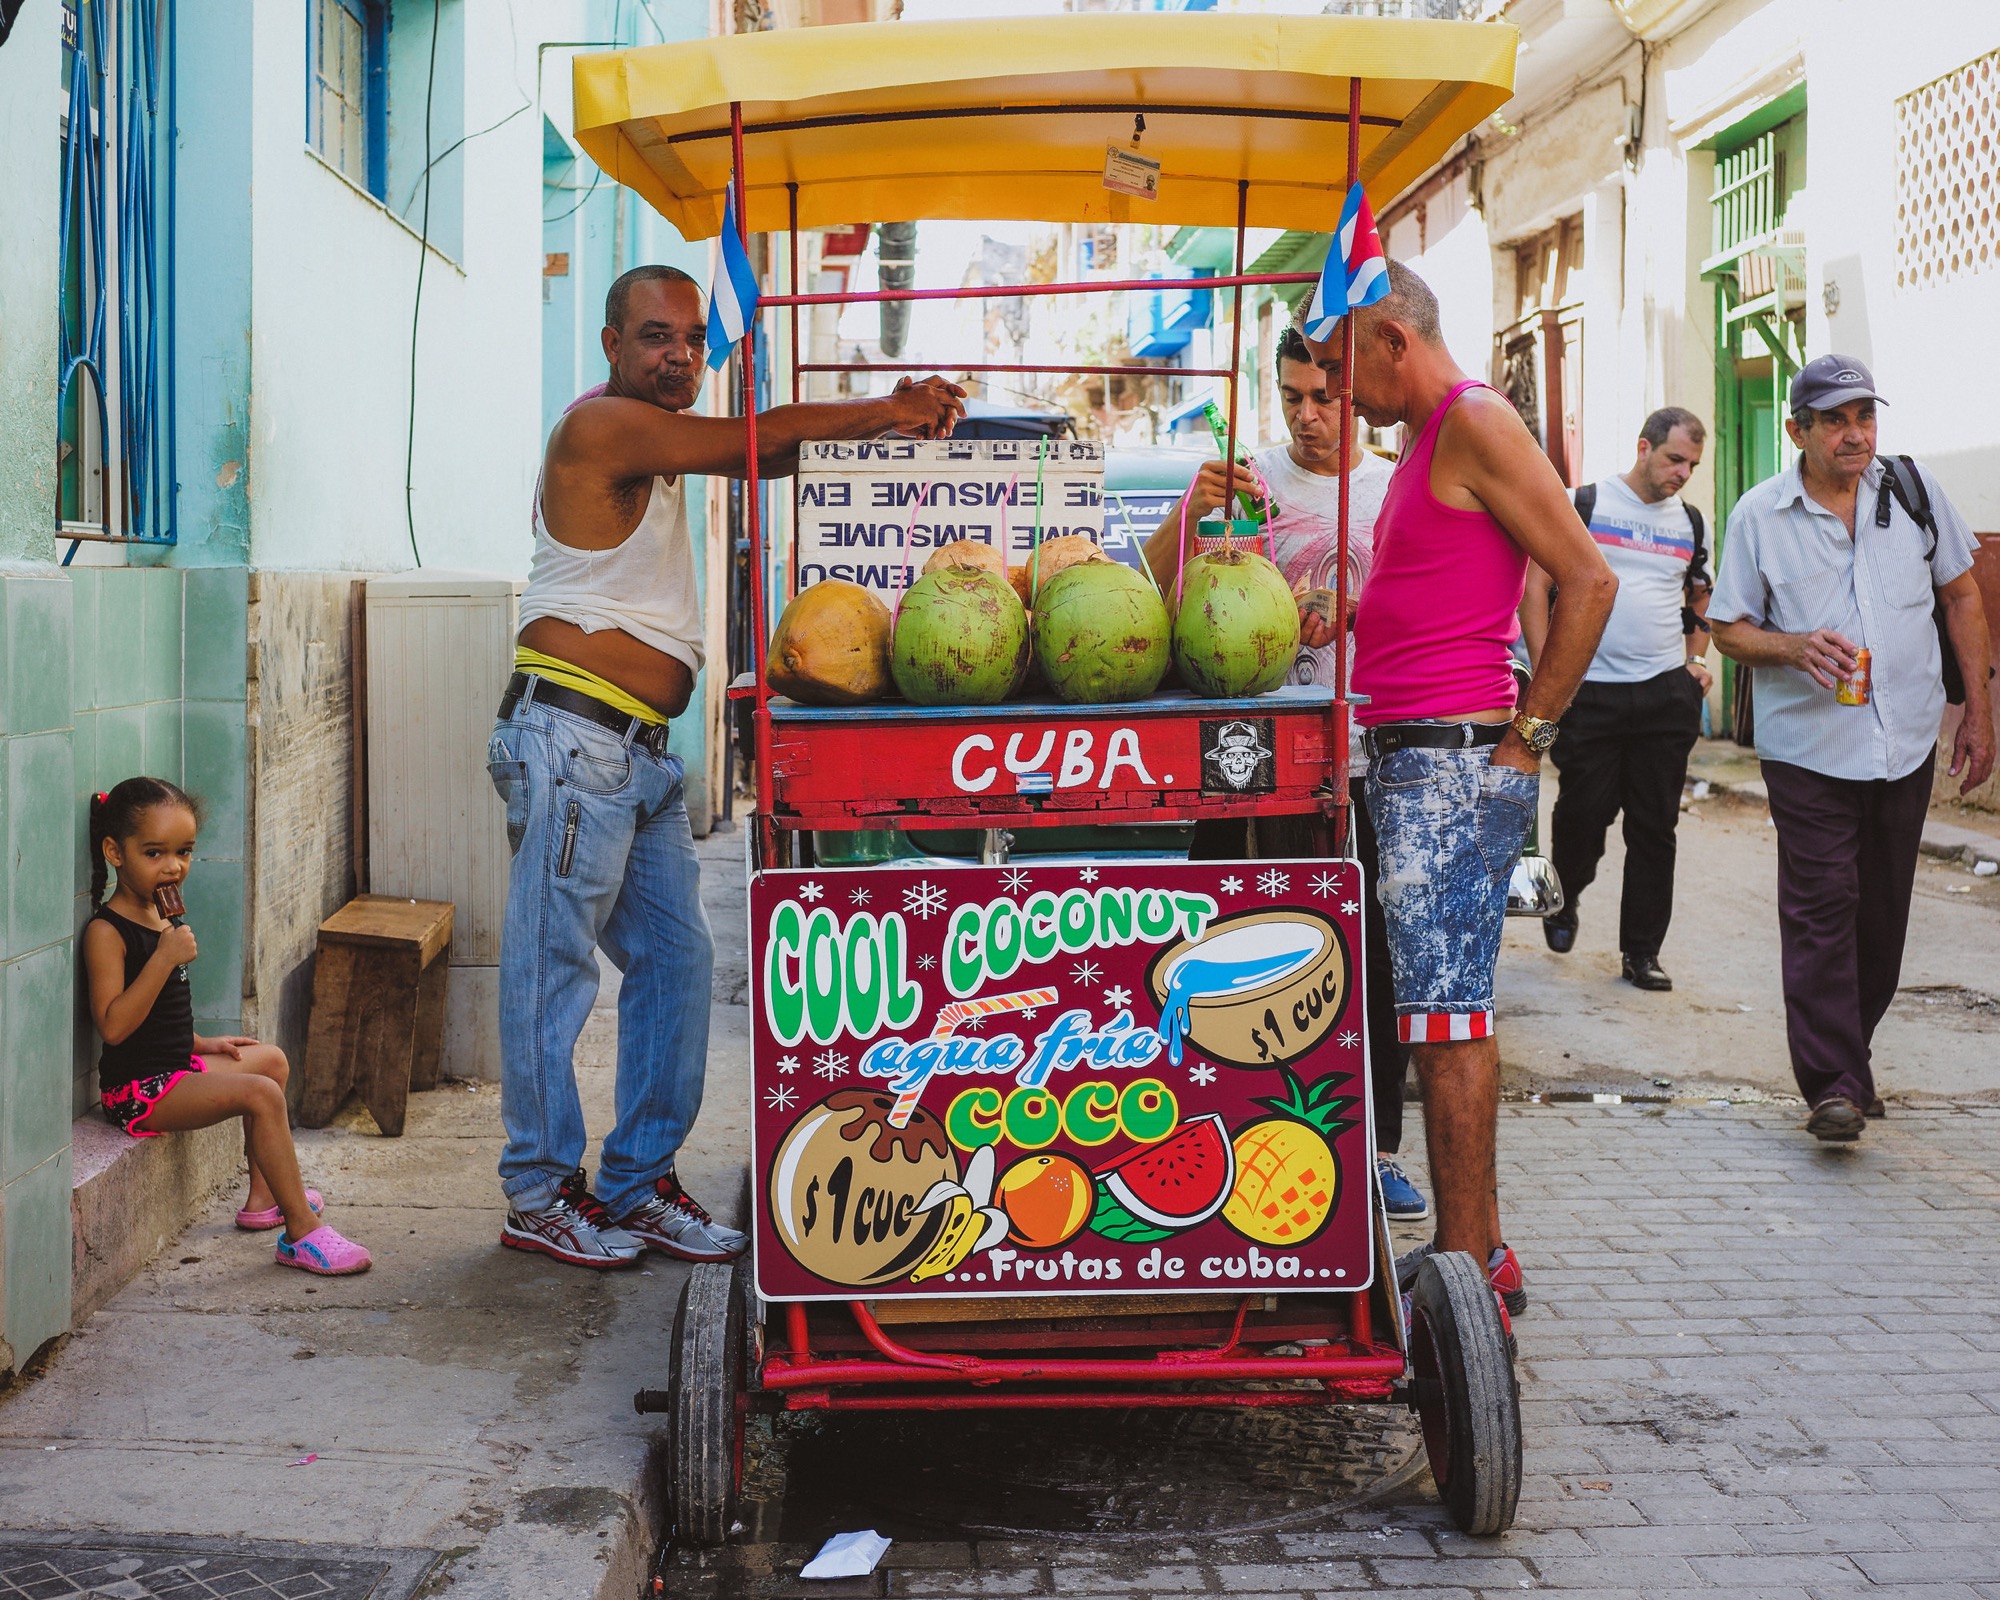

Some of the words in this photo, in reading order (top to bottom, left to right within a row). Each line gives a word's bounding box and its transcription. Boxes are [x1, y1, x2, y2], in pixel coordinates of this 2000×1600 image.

[871, 482, 1044, 507] EMSUME
[818, 522, 992, 548] EMSUME
[951, 727, 1174, 793] CUBA.
[764, 900, 923, 1047] COOL
[942, 887, 1219, 999] COCONUT
[1293, 969, 1337, 1033] CUC
[859, 1037, 1025, 1092] agua
[1015, 1008, 1162, 1089] fría
[945, 1078, 1179, 1152] COCO
[853, 1186, 915, 1246] CUC
[1137, 1247, 1185, 1280] de
